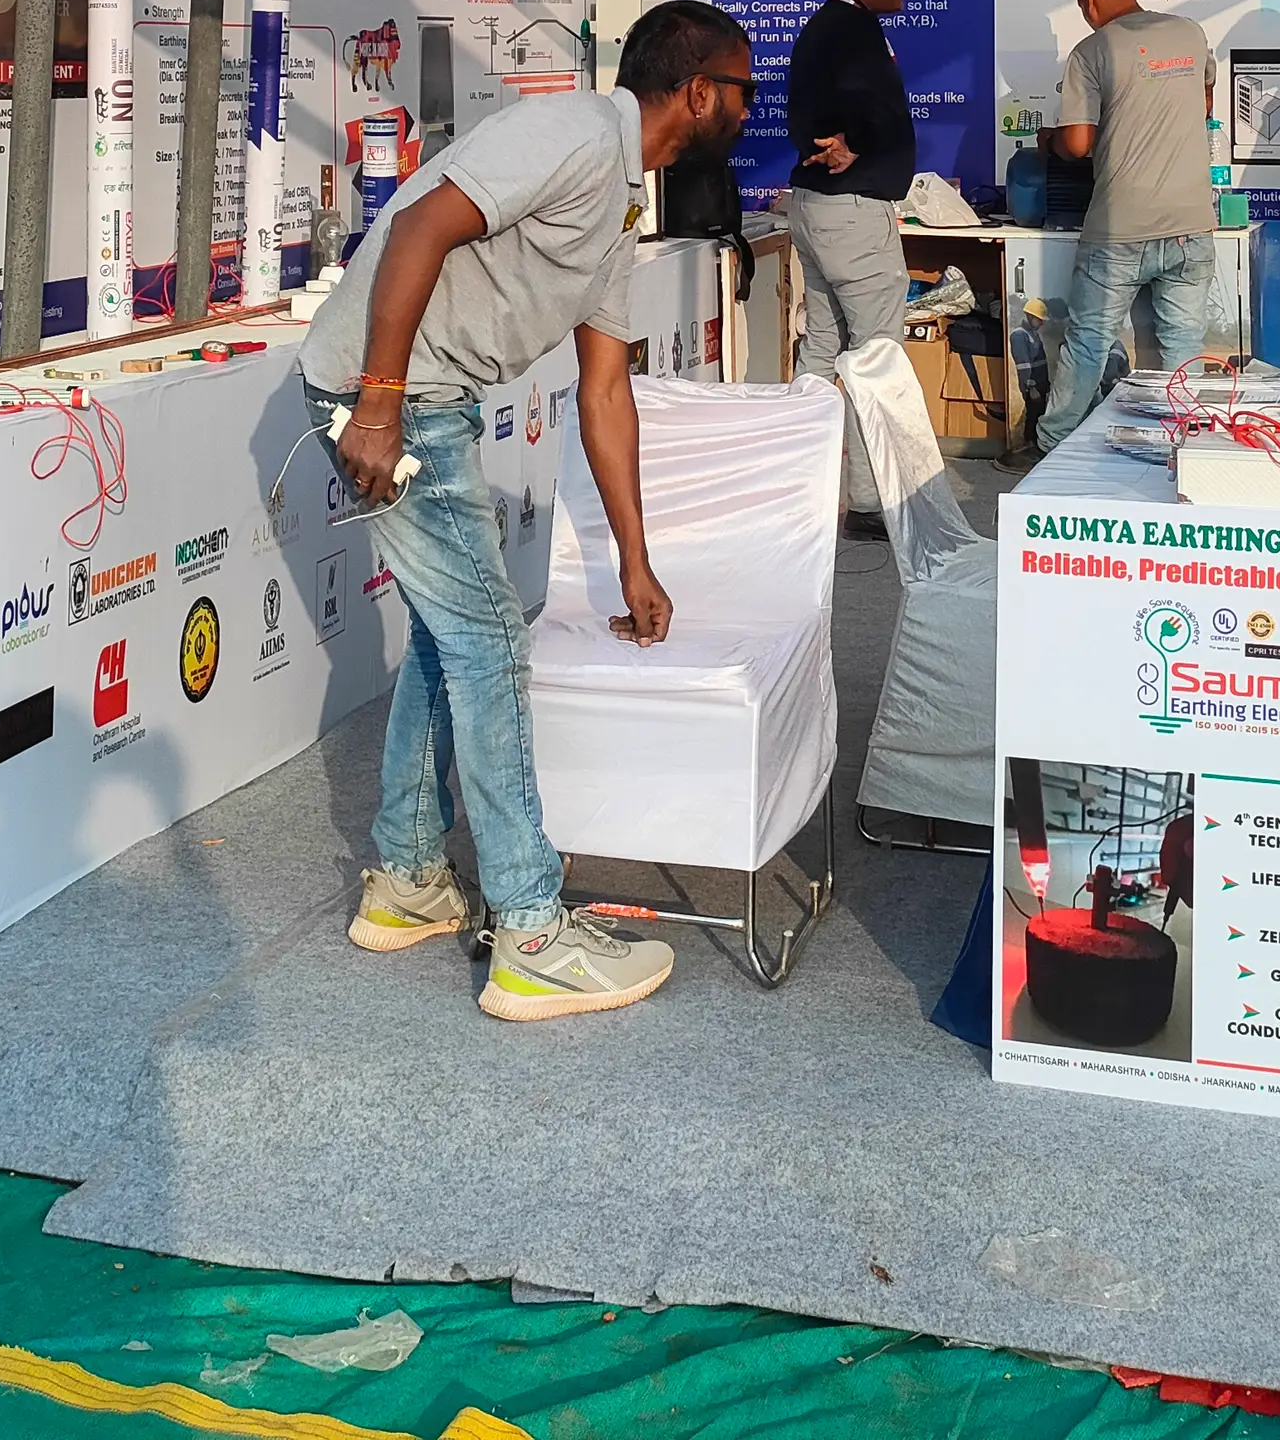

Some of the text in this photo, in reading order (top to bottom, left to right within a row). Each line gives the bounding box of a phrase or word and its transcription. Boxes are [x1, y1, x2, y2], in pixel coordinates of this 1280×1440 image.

[152, 5, 184, 20] Strength
[1148, 56, 1194, 71] Saumya
[251, 512, 300, 546] AURUM
[1025, 514, 1137, 546] SAUMYA
[175, 526, 229, 567] INDOCHEM
[91, 552, 157, 597] UNICHEM
[1021, 550, 1134, 583] Reliable,
[91, 578, 156, 617] LABORATORIES LTD.
[259, 632, 286, 662] AIIMS
[1170, 698, 1247, 721] Earthing
[92, 713, 141, 748] Choithram Hospital
[92, 727, 146, 762] and Research Centre
[1004, 1051, 1070, 1068] CHHATTISGARH
[1080, 1060, 1147, 1078] MAHARASHTRA
[1157, 1070, 1191, 1084] ODISHA
[1201, 1076, 1256, 1091] JHARKHAND
